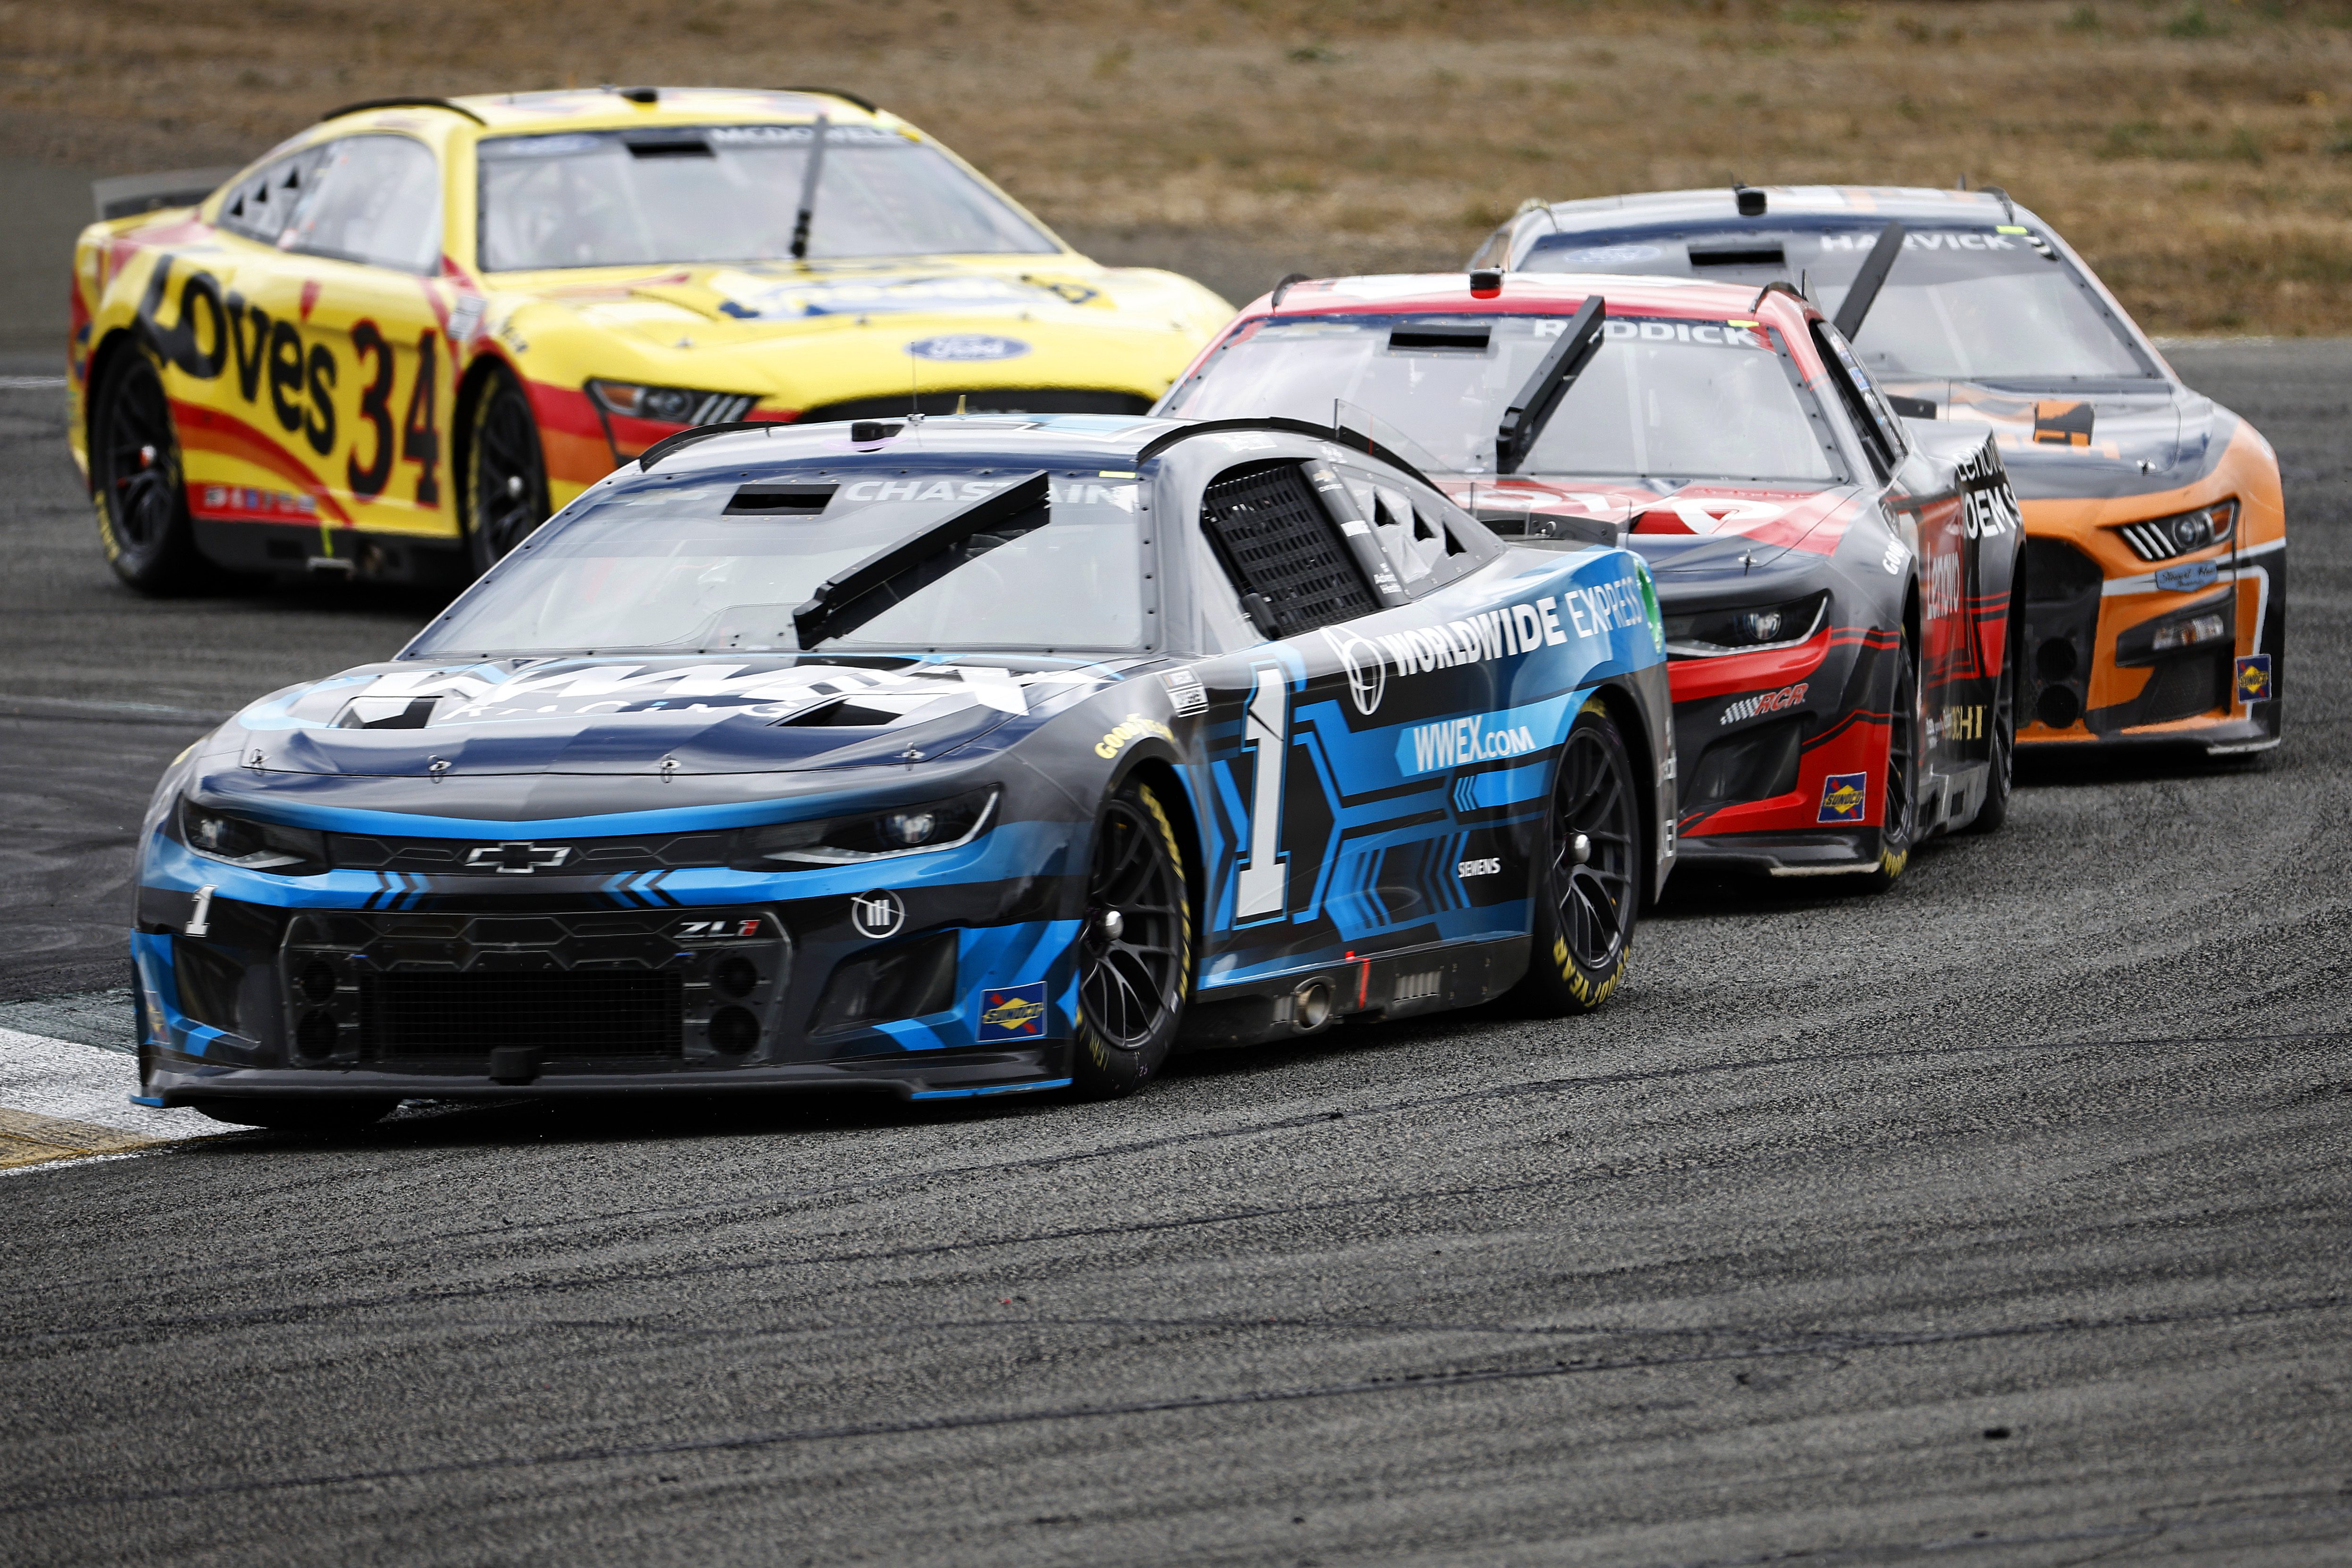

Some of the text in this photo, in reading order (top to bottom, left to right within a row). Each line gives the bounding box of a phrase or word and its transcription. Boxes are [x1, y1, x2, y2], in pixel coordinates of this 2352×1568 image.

[1820, 233, 2018, 250] HAVICK
[1535, 318, 1760, 346] RDDICK
[348, 318, 439, 508] 34
[1927, 541, 1960, 621] Lenovo
[1376, 576, 1643, 676] WORLDWIDE EXPRESS
[1754, 683, 1809, 716] RCR
[1414, 715, 1535, 772] WWEX.COM
[1234, 667, 1287, 919] 1
[1824, 790, 1863, 807] SUNOCO
[1458, 857, 1501, 878] SIEMENS
[185, 884, 218, 937] 1
[672, 920, 762, 938] ZL1
[981, 1002, 1044, 1024] SUNOCO
